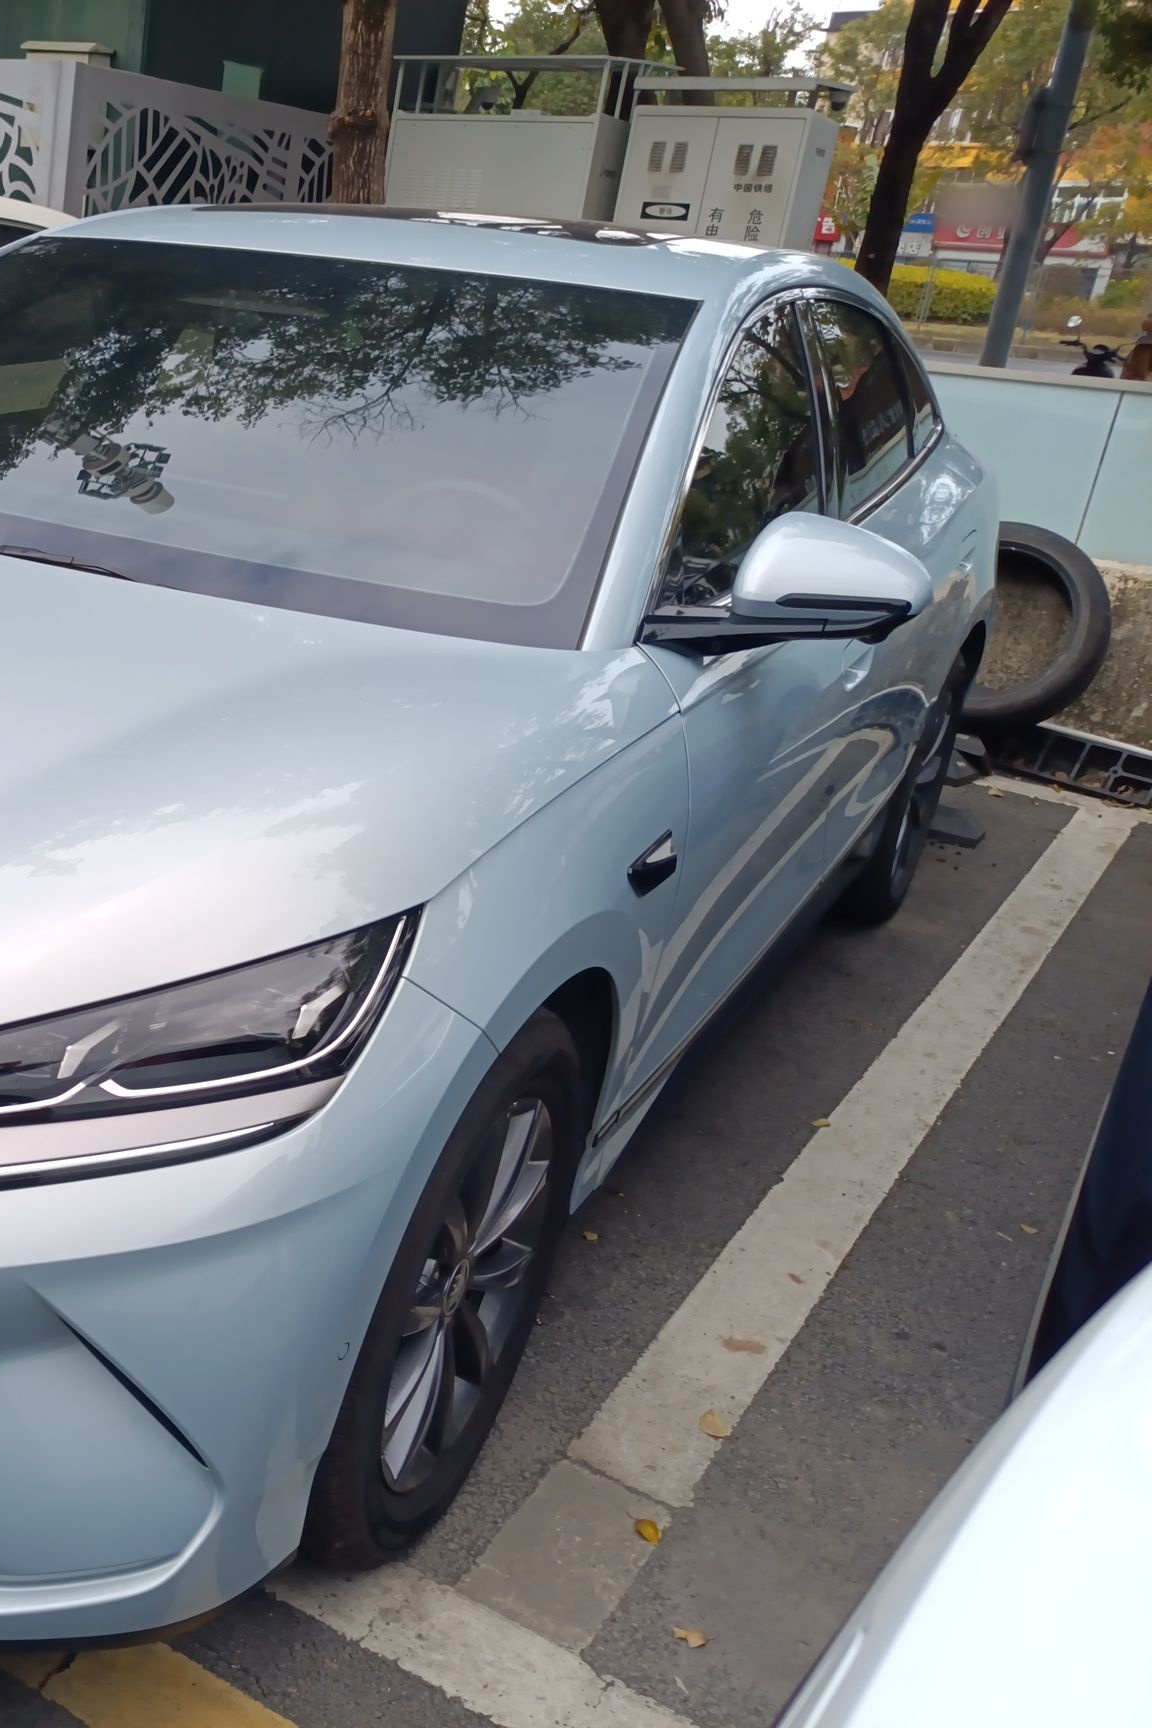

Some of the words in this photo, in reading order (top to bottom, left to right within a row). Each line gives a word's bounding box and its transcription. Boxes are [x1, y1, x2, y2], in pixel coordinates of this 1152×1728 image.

[733, 183, 773, 194] 中国铁塔
[743, 208, 765, 242] 危险
